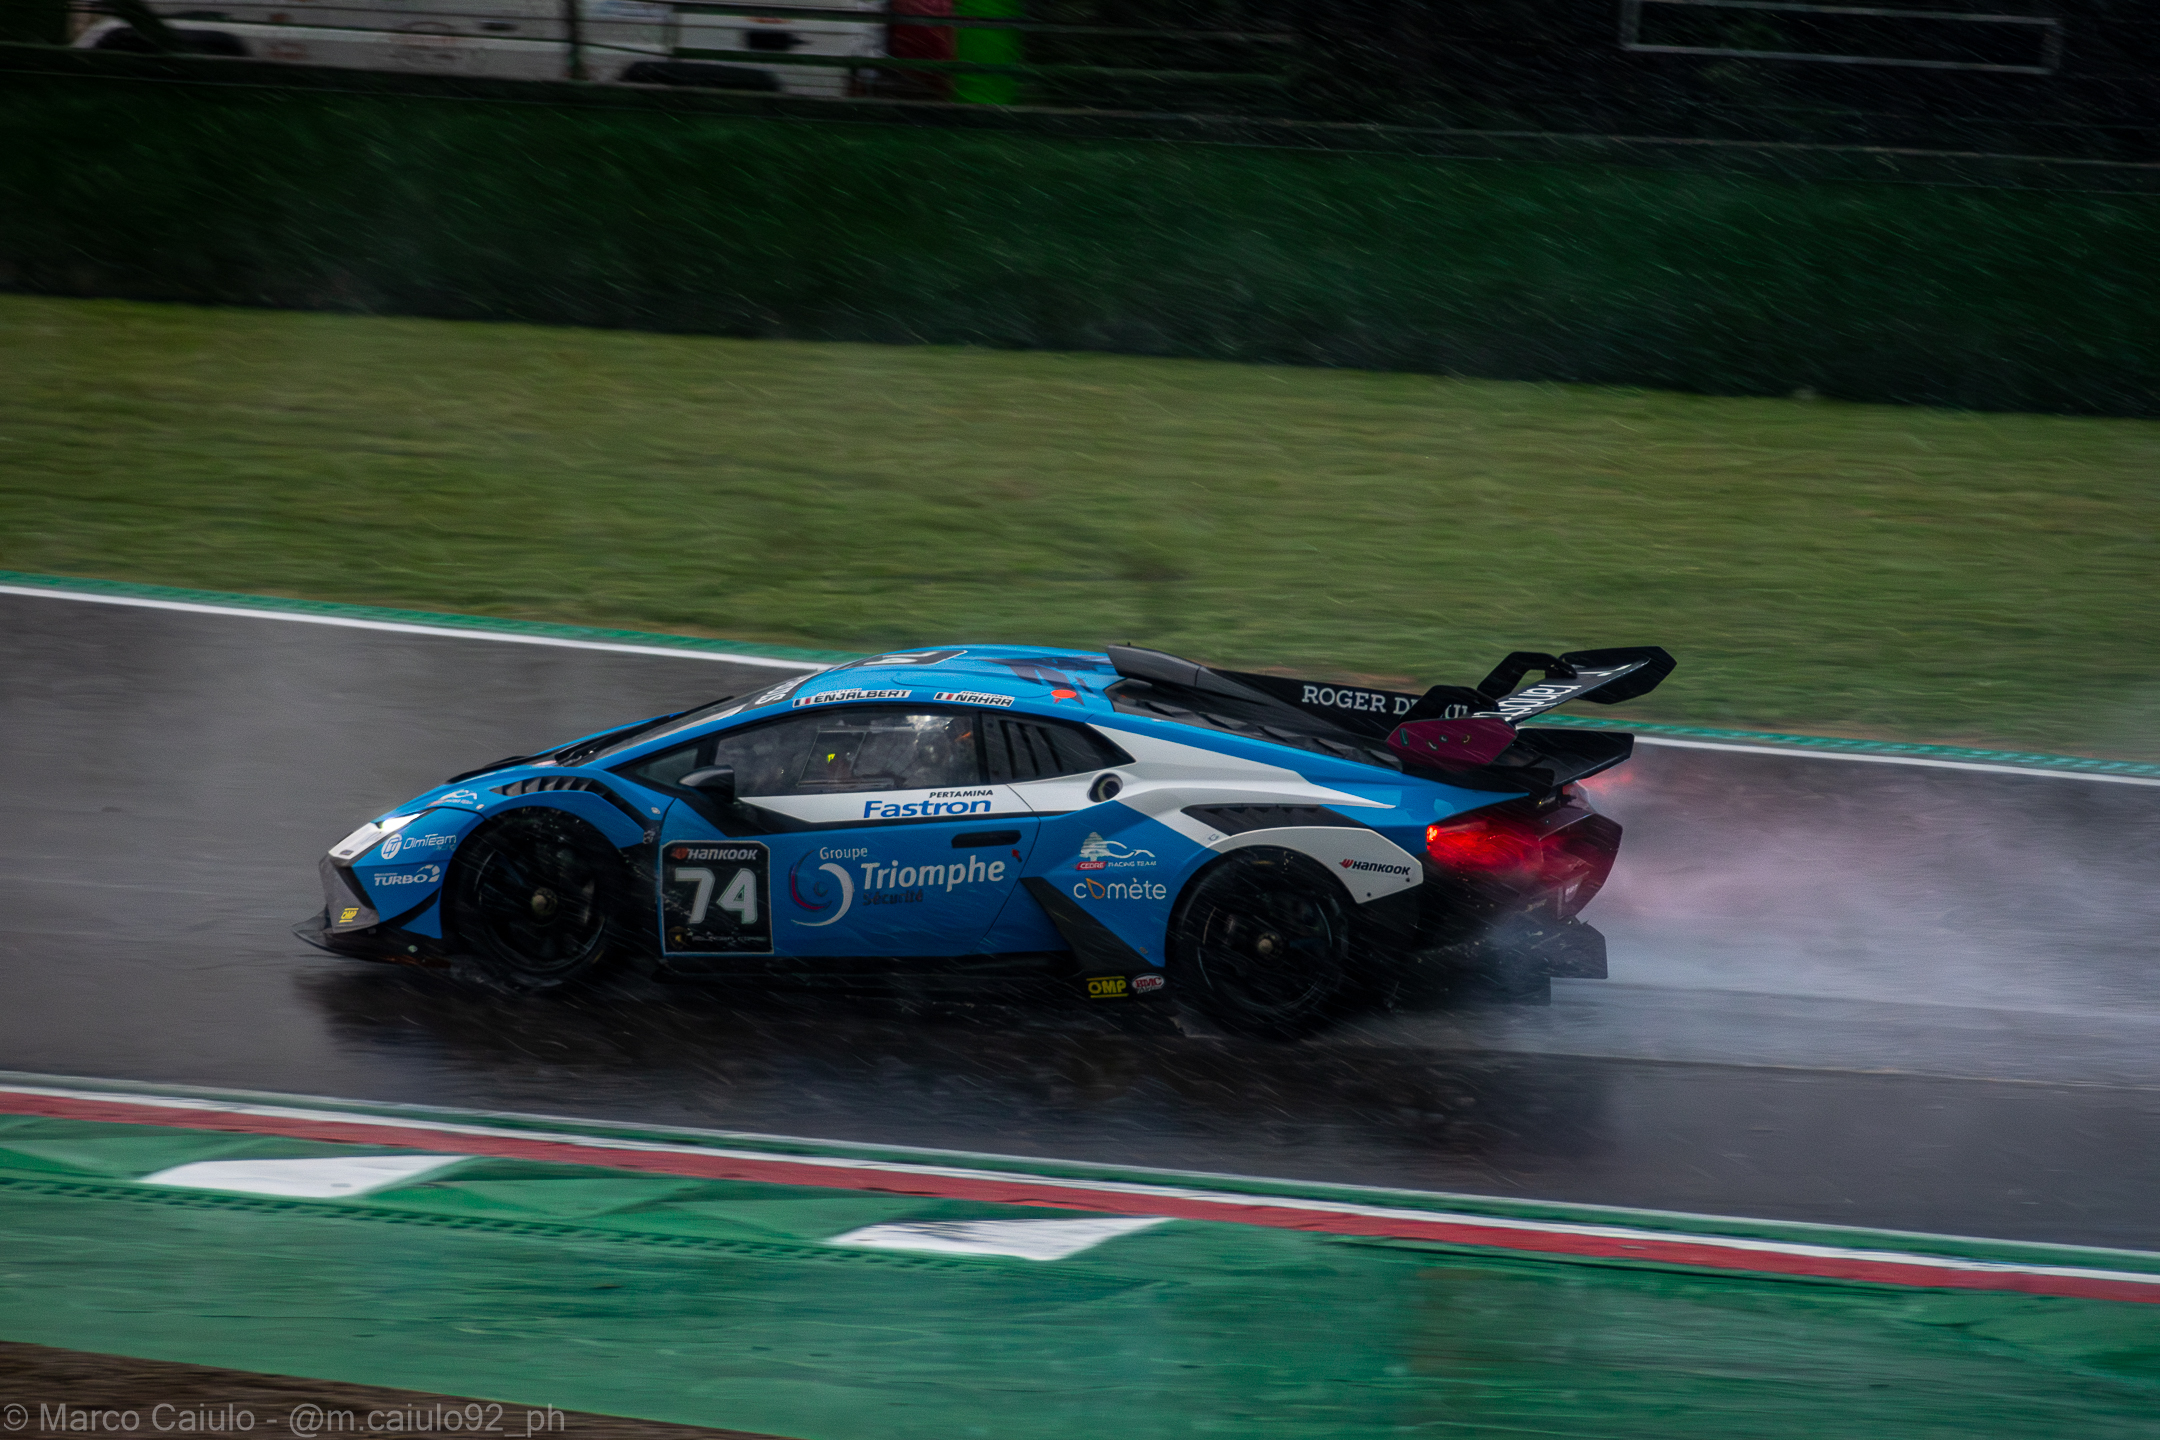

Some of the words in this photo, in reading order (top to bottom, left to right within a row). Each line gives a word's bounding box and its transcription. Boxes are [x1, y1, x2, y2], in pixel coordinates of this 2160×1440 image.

[814, 690, 908, 703] ENJALBERT
[955, 694, 1013, 706] NAHRA
[1302, 685, 1387, 714] ROGER
[929, 789, 994, 798] PERTAMINA
[863, 800, 992, 819] Fastron
[819, 846, 868, 861] Groupe
[373, 873, 428, 886] TURBO
[861, 854, 1006, 892] Triomphe
[674, 867, 759, 925] 74
[1087, 979, 1127, 995] OMP
